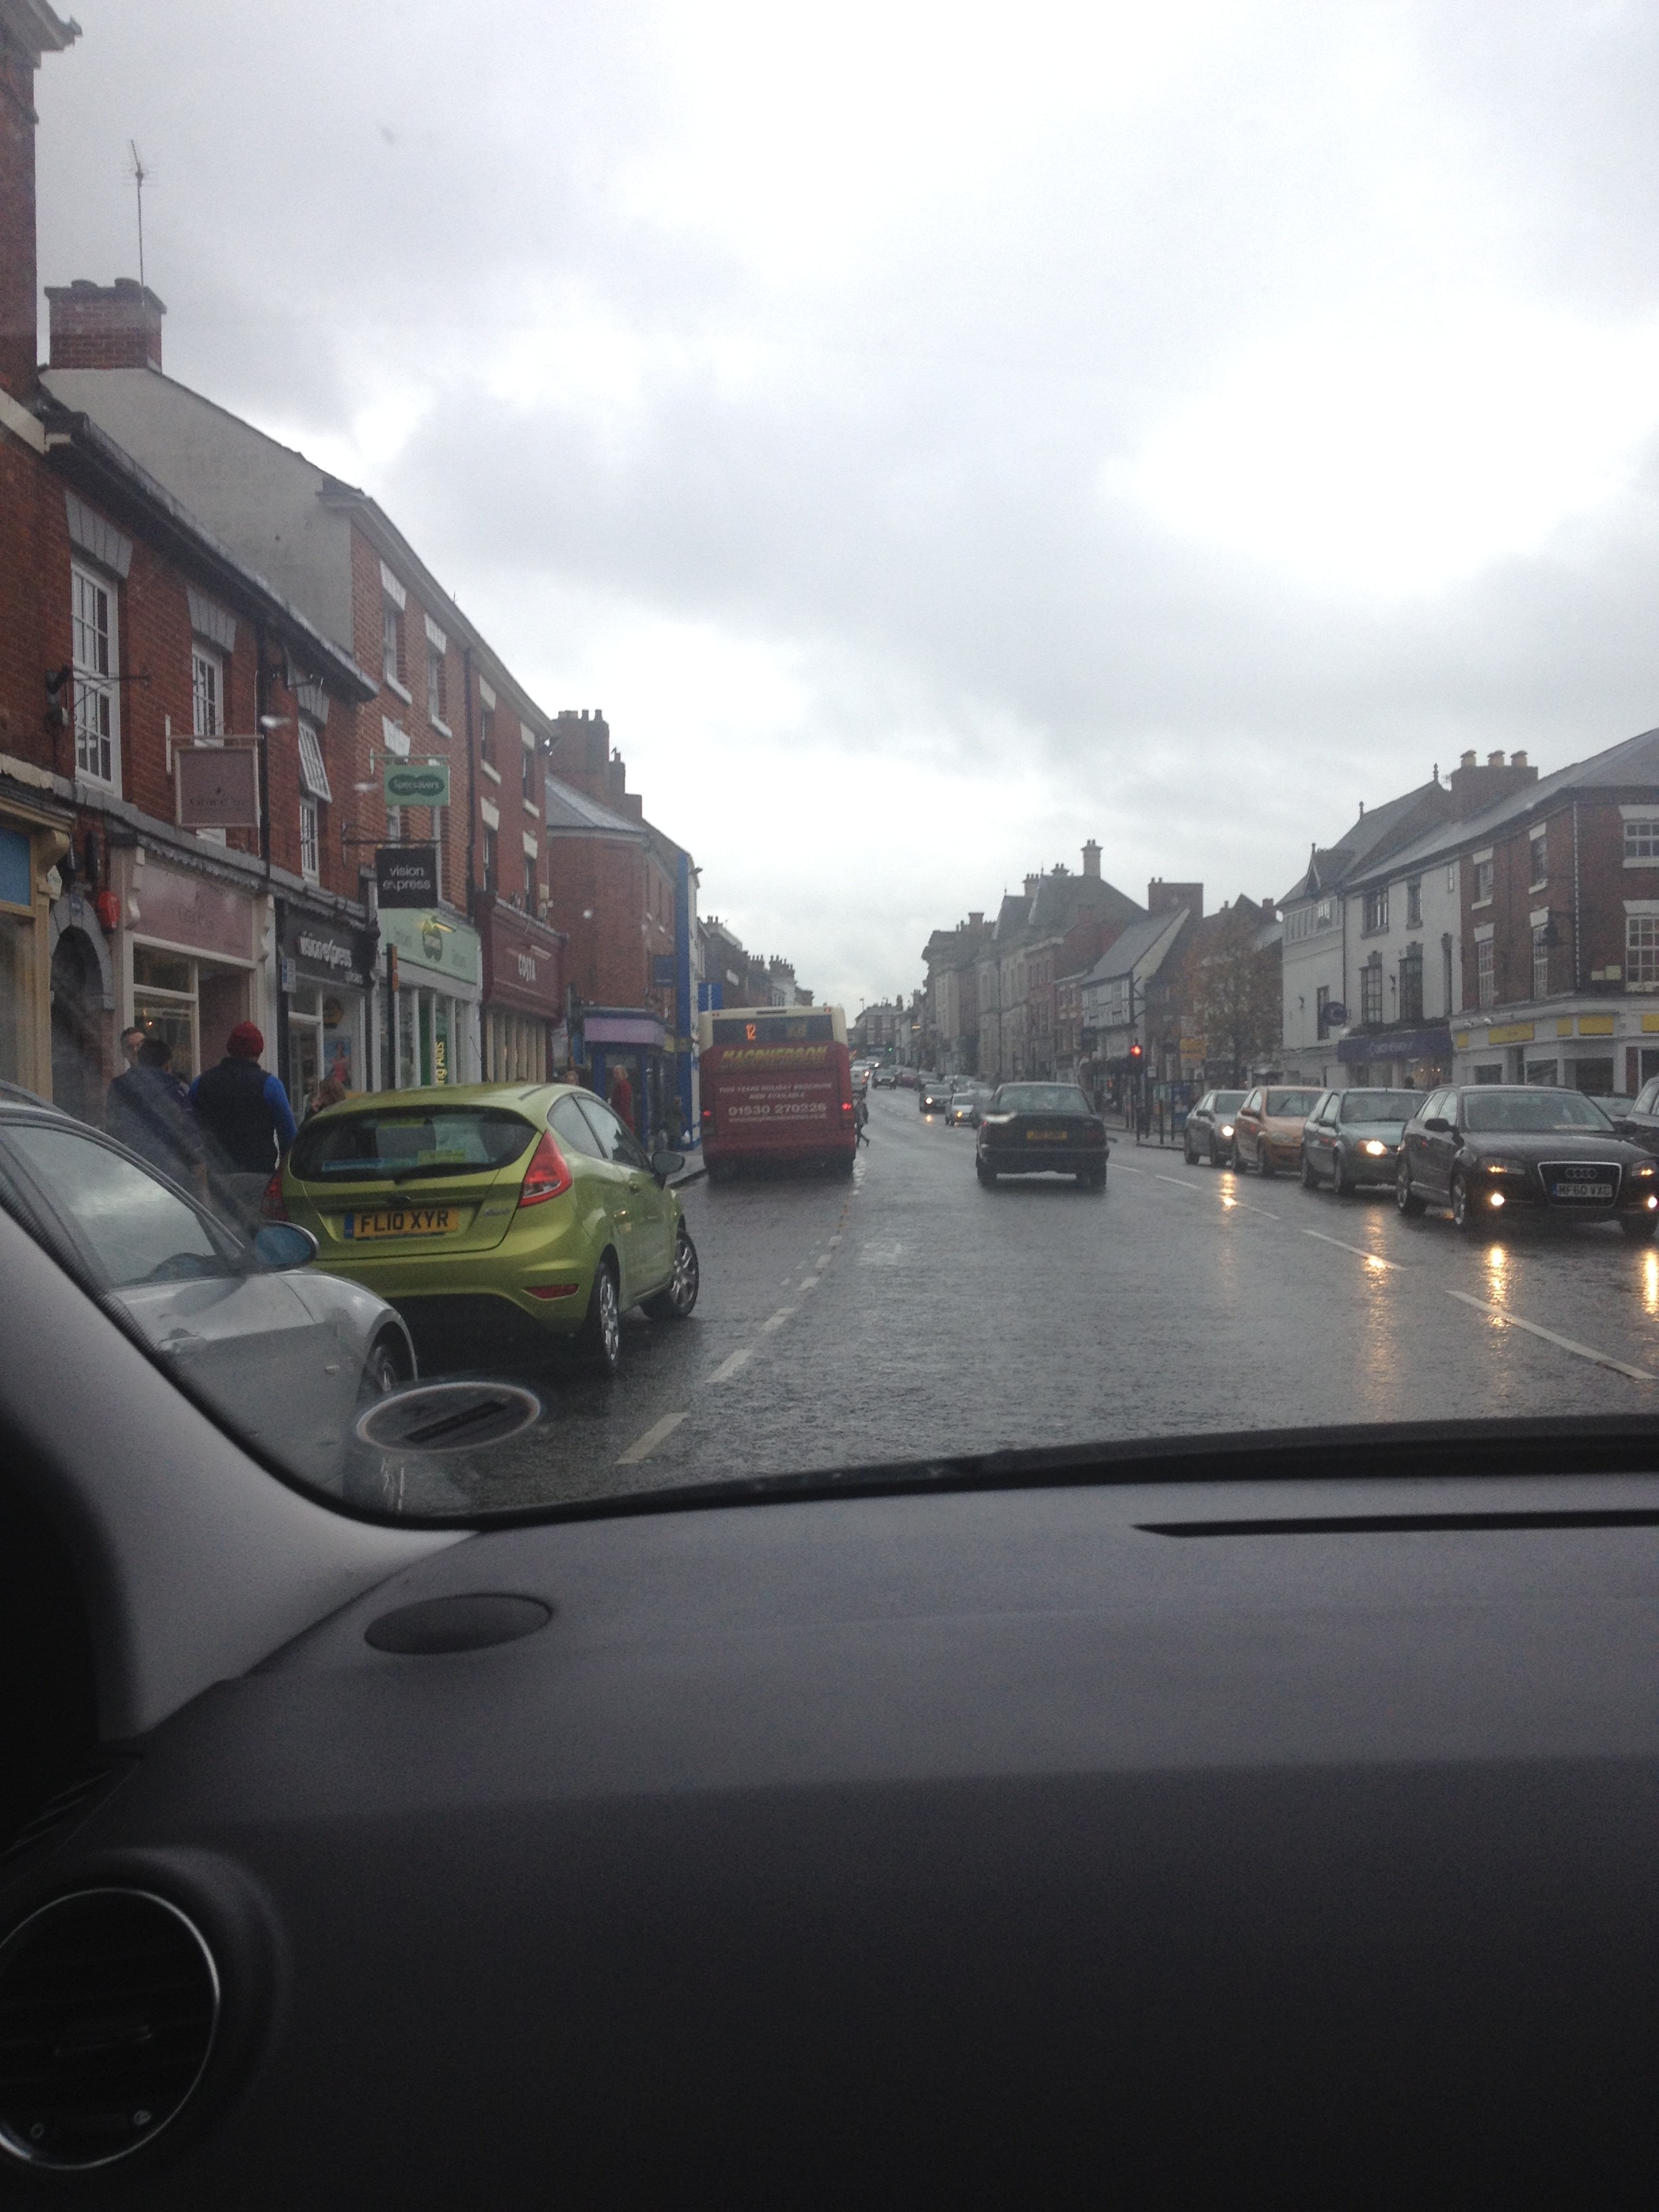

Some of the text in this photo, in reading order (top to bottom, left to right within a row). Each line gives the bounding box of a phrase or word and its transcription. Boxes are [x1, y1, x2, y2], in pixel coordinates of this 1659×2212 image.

[389, 864, 424, 877] vision
[518, 953, 536, 982] COSTA
[728, 1105, 771, 1117] 01530
[361, 1210, 449, 1233] FL10 XYR
